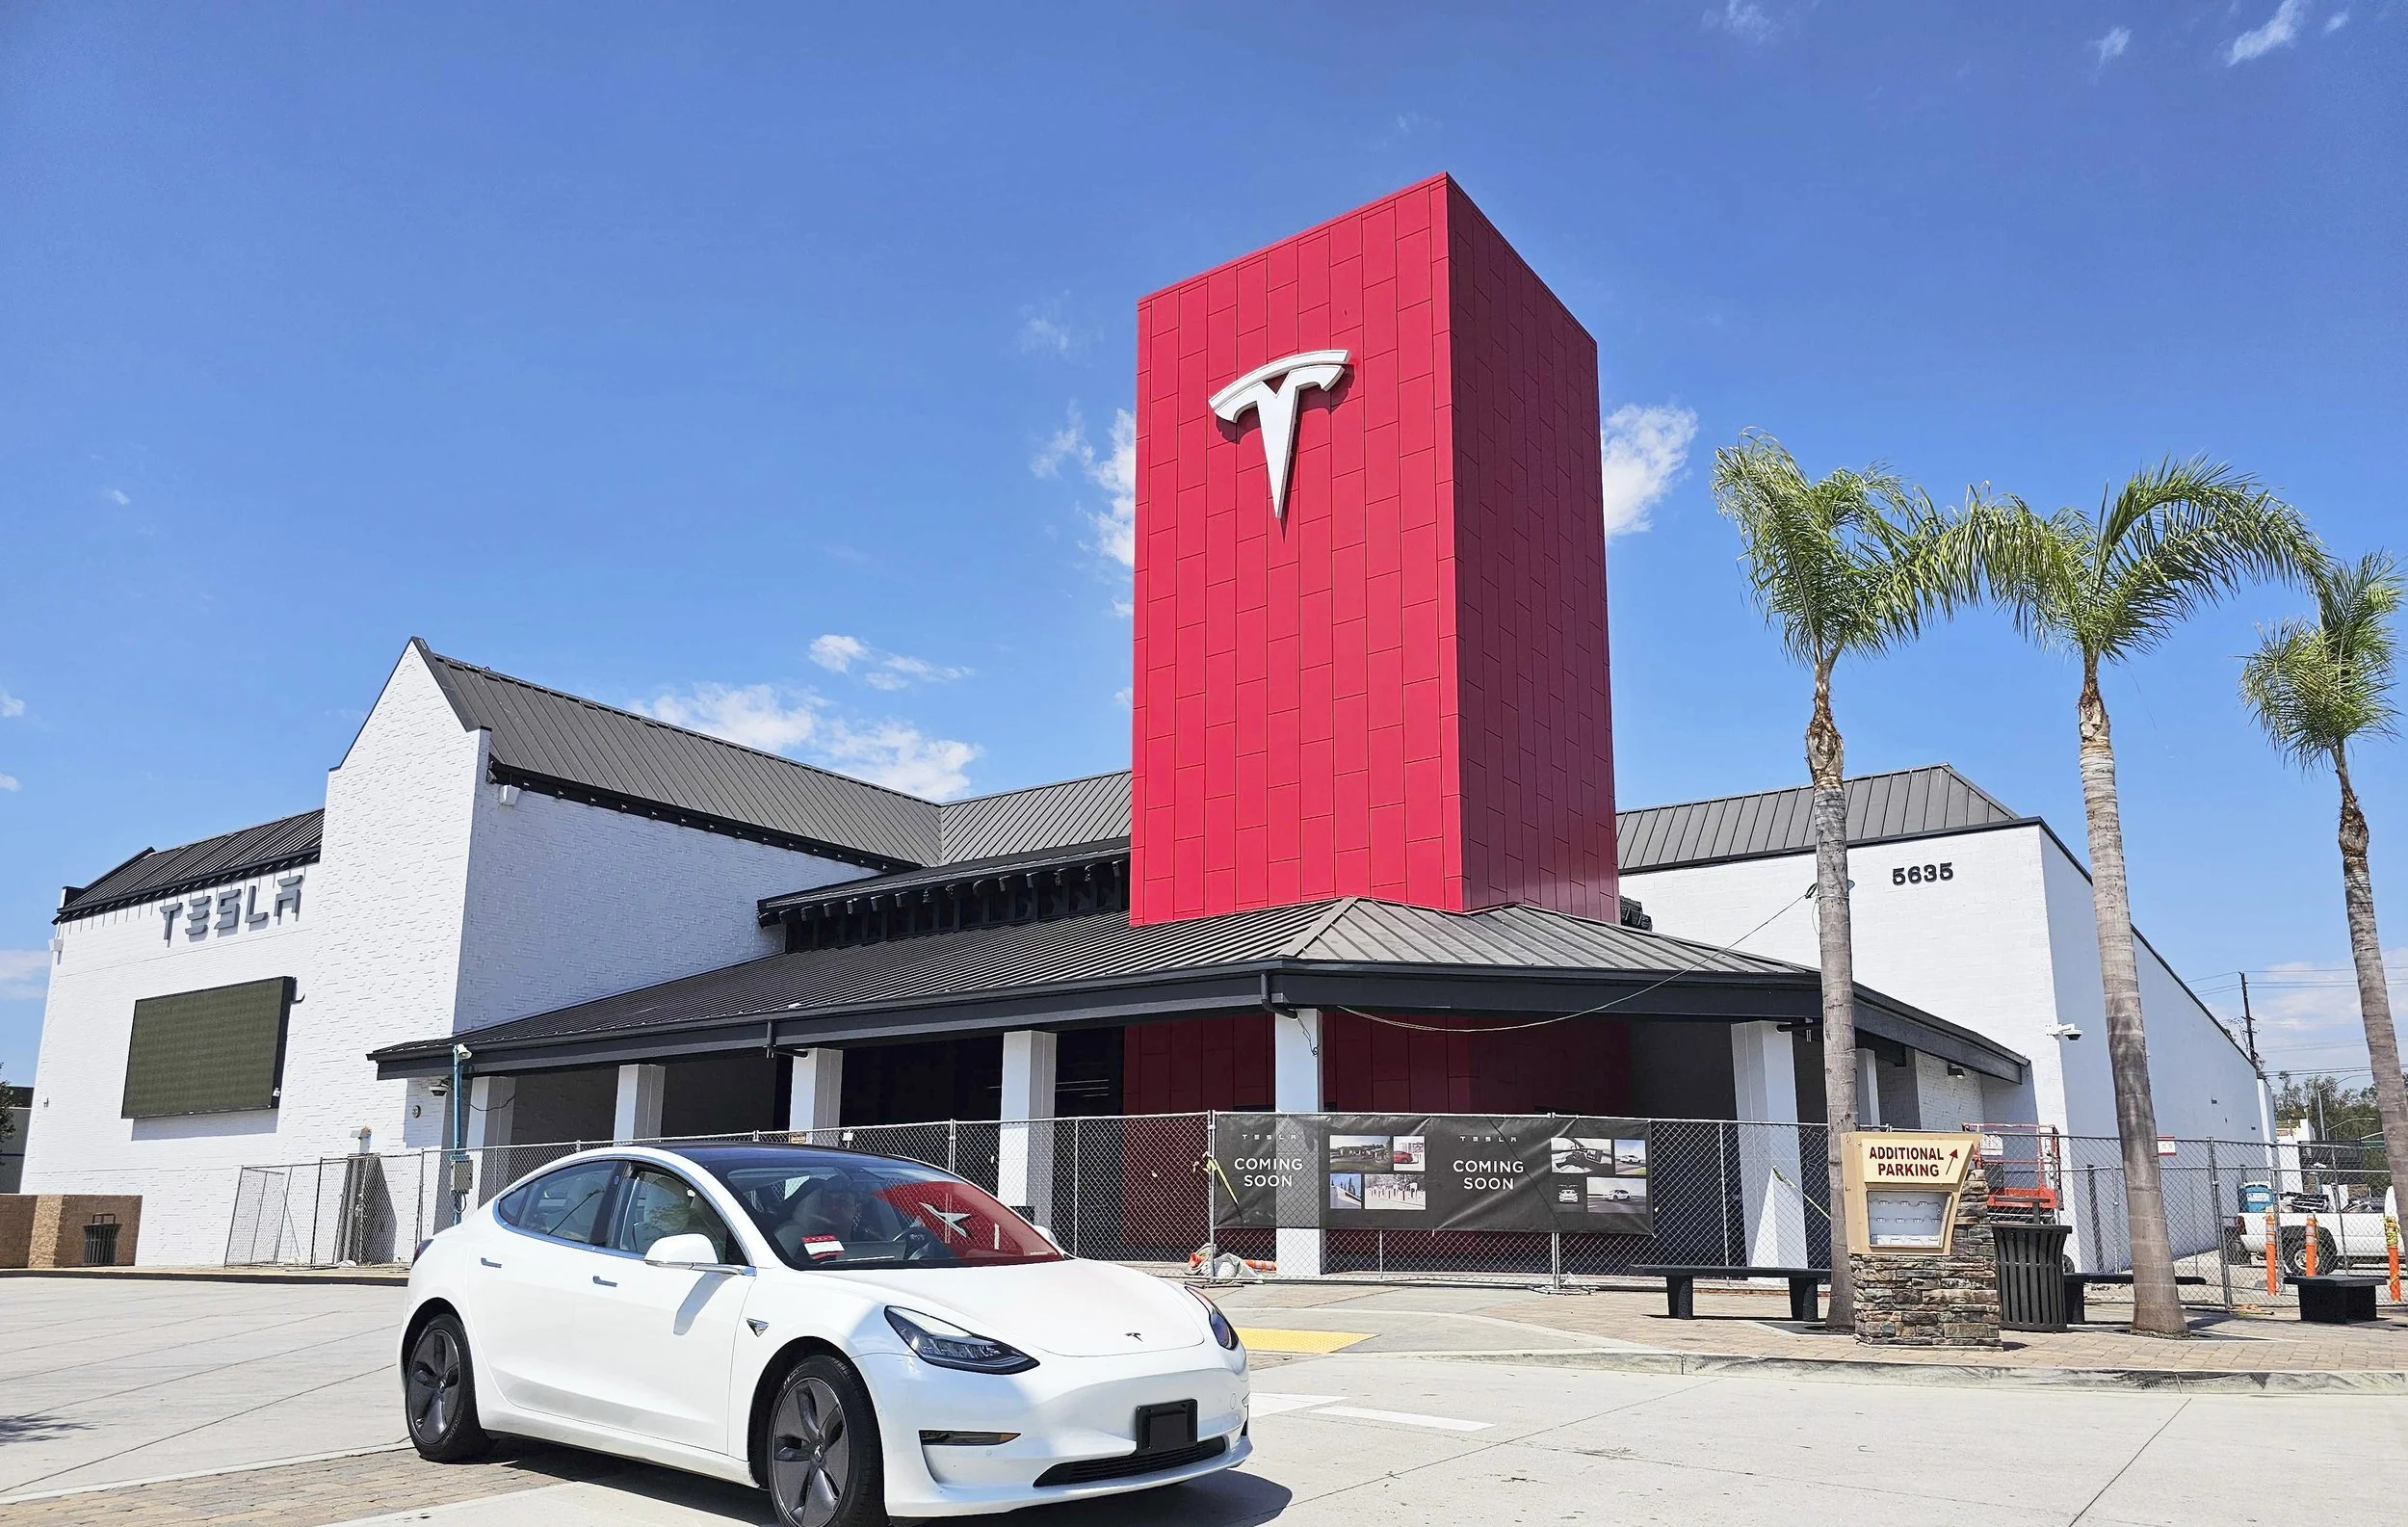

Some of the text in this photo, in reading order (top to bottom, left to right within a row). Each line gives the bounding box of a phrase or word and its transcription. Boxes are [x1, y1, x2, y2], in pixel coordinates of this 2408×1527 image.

[1892, 861, 1953, 886] 5635
[160, 874, 304, 941] TESLA
[1869, 1146, 1945, 1161] ADDITIONAL
[1234, 1157, 1303, 1171] COMING
[1453, 1160, 1524, 1173] COMING
[1877, 1163, 1940, 1177] PARKING
[1243, 1174, 1293, 1187] SOON
[1463, 1177, 1514, 1190] SOON
